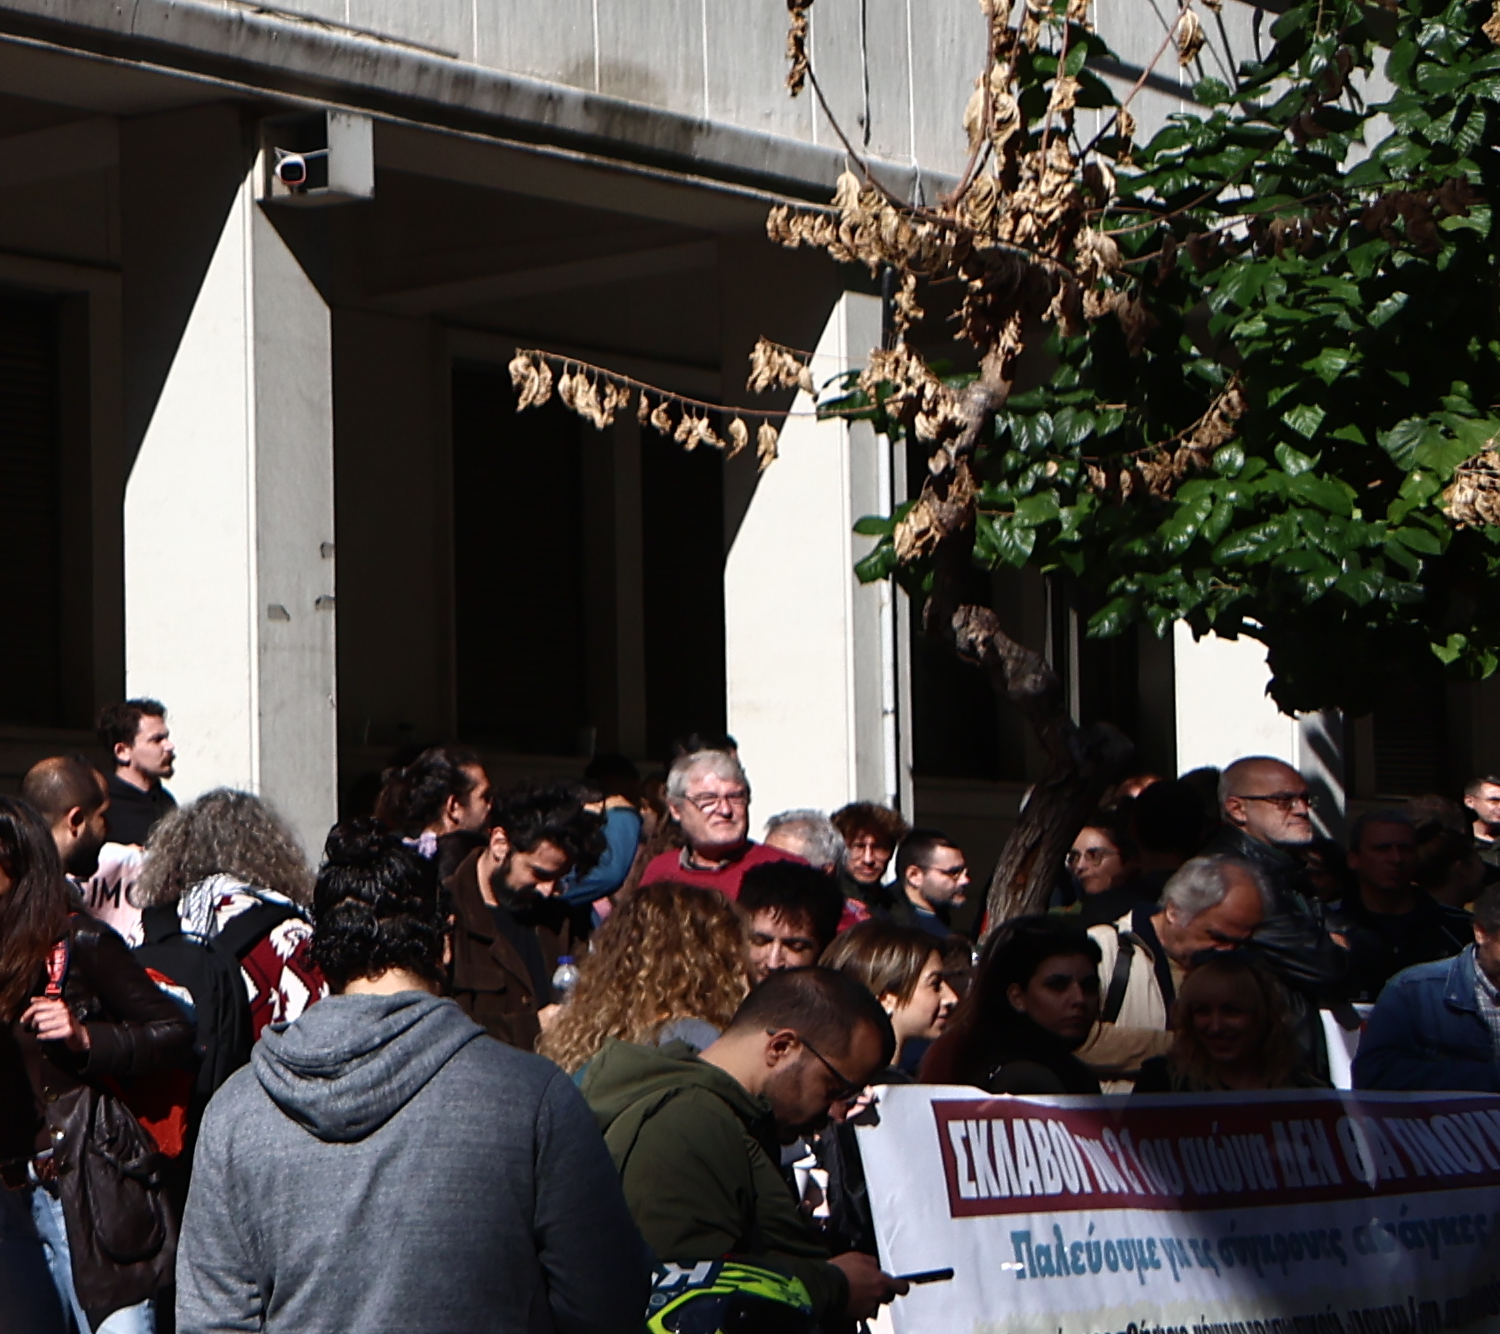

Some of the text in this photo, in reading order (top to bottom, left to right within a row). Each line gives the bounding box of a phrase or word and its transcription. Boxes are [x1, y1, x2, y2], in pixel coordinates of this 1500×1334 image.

[947, 1118, 1093, 1199] ΣΚΛΑΒΟΙ
[1270, 1117, 1343, 1188] ΔΕΝ
[1011, 1221, 1161, 1286] Παλεύουμε
